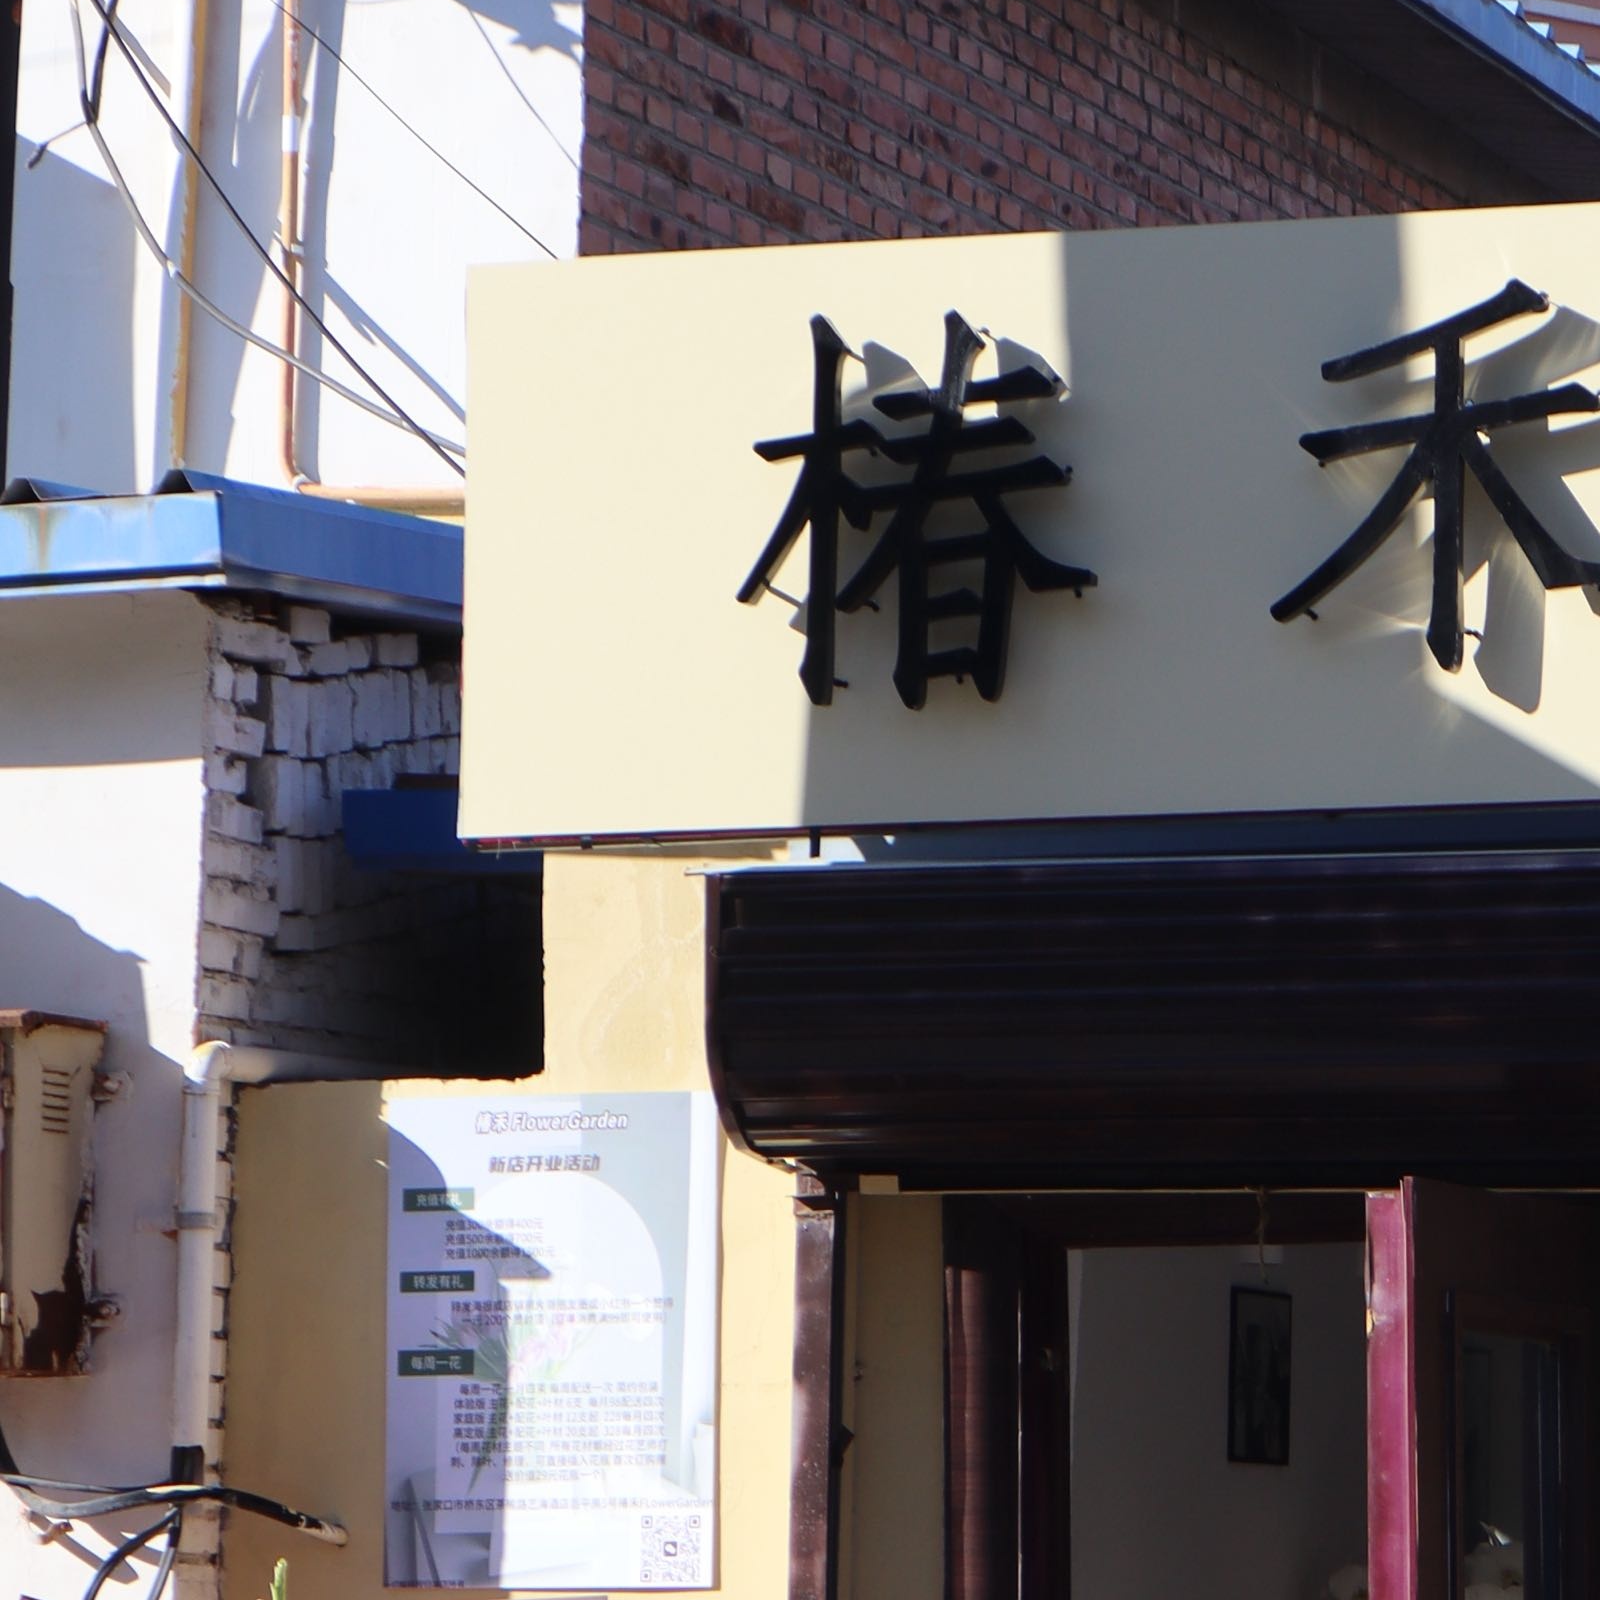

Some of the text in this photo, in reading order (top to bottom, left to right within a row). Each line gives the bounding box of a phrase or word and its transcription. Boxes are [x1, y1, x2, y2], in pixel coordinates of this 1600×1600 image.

[511, 1111, 628, 1132] FlowerGarden
[489, 1154, 600, 1173] 新店开业活动
[412, 1274, 465, 1290] 转发有礼
[410, 1355, 462, 1372] 每周一花
